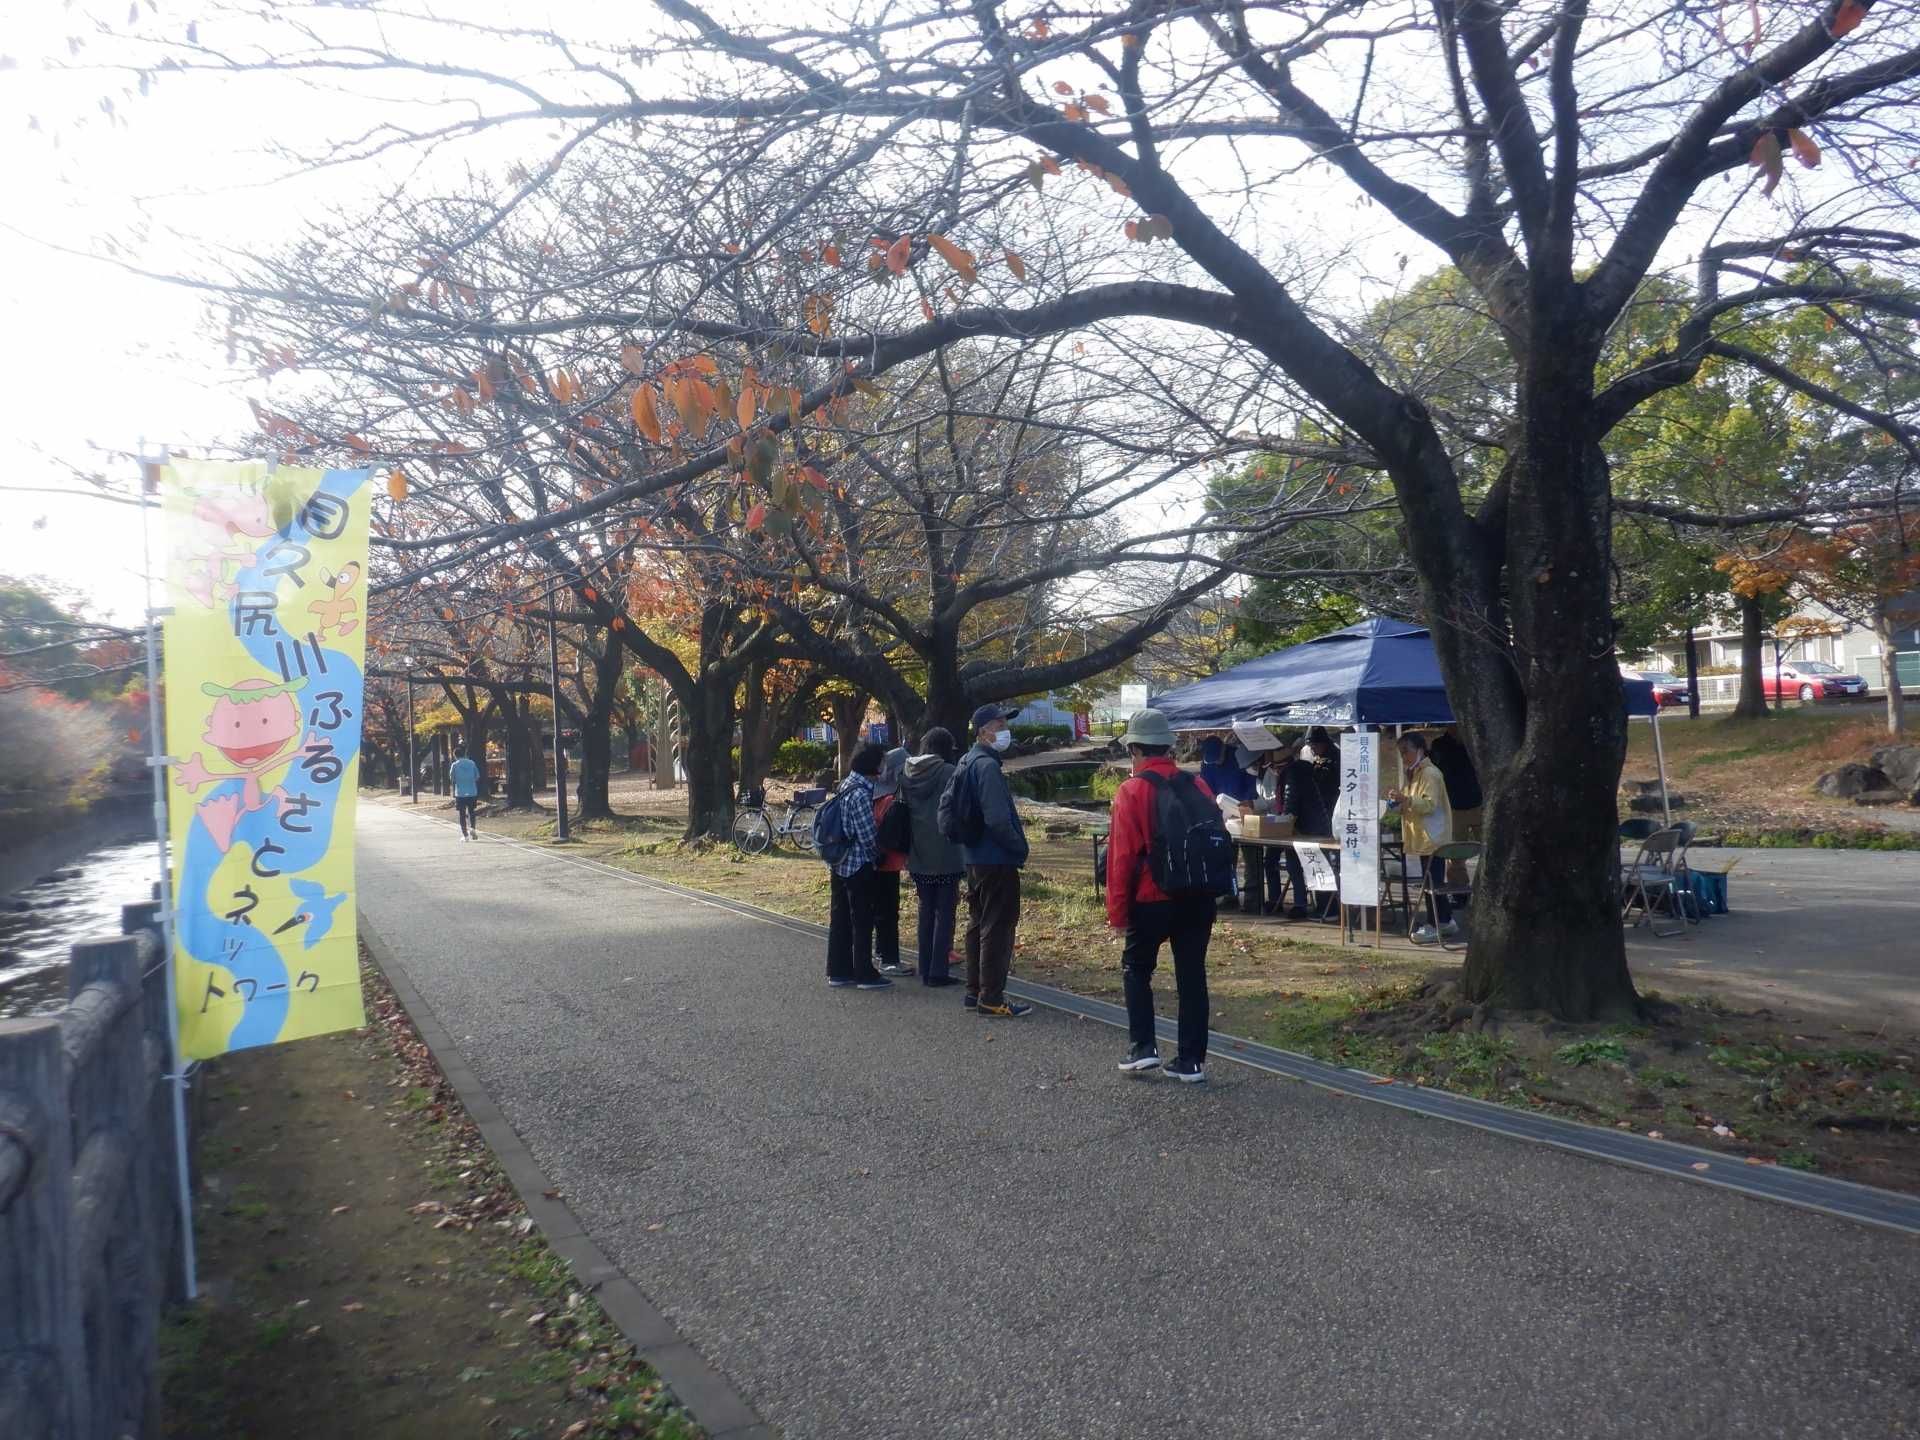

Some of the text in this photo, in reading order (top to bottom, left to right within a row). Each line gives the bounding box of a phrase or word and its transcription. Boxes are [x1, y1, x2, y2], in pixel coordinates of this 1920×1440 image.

[1345, 768, 1359, 849] スタート受付
[1301, 847, 1326, 888] 受付
